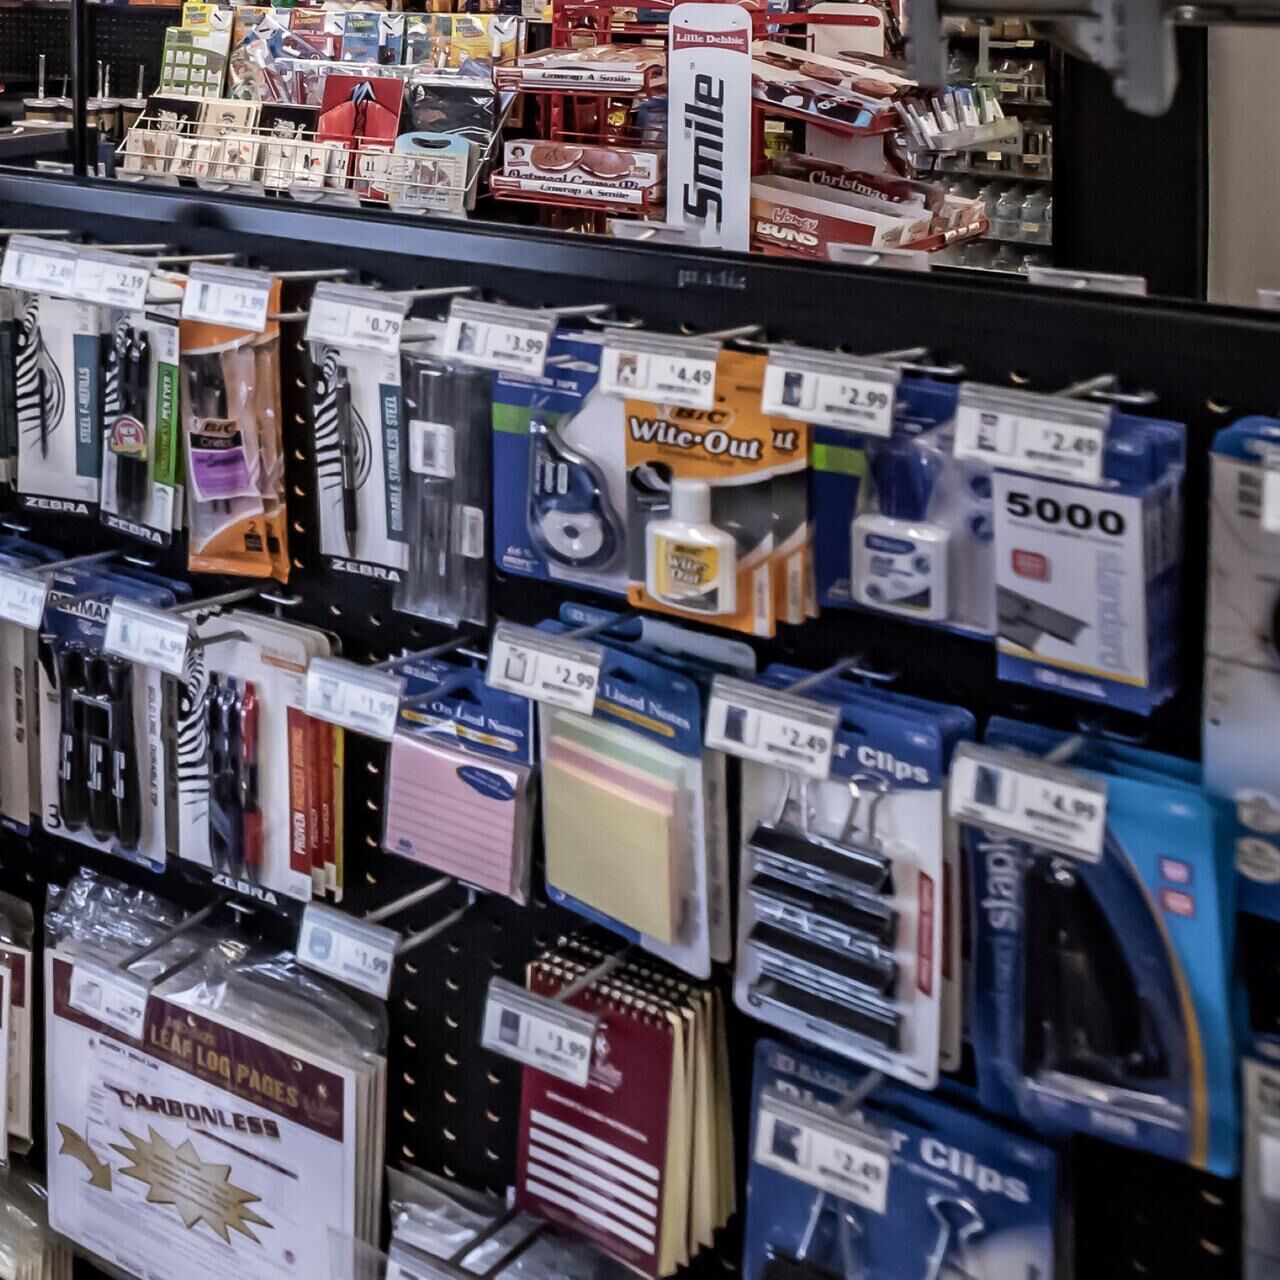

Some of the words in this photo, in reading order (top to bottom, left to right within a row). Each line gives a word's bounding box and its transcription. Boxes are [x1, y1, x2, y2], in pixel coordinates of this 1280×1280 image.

[675, 33, 704, 45] Little
[705, 34, 745, 46] Debbie
[589, 72, 596, 81] A
[599, 73, 632, 84] Smile
[683, 74, 725, 225] Smile
[584, 188, 594, 196] A
[596, 190, 631, 200] Smile
[808, 169, 889, 202] Christmas
[756, 220, 820, 248] BUNS
[116, 272, 144, 289] $2.19
[234, 292, 266, 311] $3.99
[364, 314, 400, 337] $0.79
[505, 333, 544, 355] $3.99
[162, 375, 173, 400] EVER
[669, 364, 712, 387] $4.49
[161, 401, 172, 420] PEN
[384, 395, 398, 426] STEEL
[840, 385, 889, 410] $2.99
[80, 416, 92, 444] STEEL
[203, 421, 233, 433] BIC
[387, 429, 401, 482] STAINLESS
[1043, 430, 1100, 455] $2.49
[24, 495, 90, 515] ZEBRA
[389, 483, 404, 532] DURABLE
[1005, 490, 1127, 537] 5000
[106, 516, 164, 546] ZEBRA
[331, 557, 402, 584] ZEBRA
[555, 664, 595, 691] $2.99
[603, 682, 646, 711] Lined
[647, 700, 692, 730] Notes
[487, 718, 525, 738] Notes
[781, 726, 829, 755] $2.49
[857, 744, 930, 785] Clips
[150, 792, 159, 807] TIP
[47, 803, 62, 830] 3
[293, 811, 306, 855] PROVEN
[211, 873, 279, 907] ZEBRA
[354, 947, 391, 975] $1.99
[149, 1022, 192, 1058] LEAF
[236, 1062, 299, 1109] PAGES
[117, 1087, 281, 1140] CARBONLESS
[919, 1136, 1032, 1205] Clips
